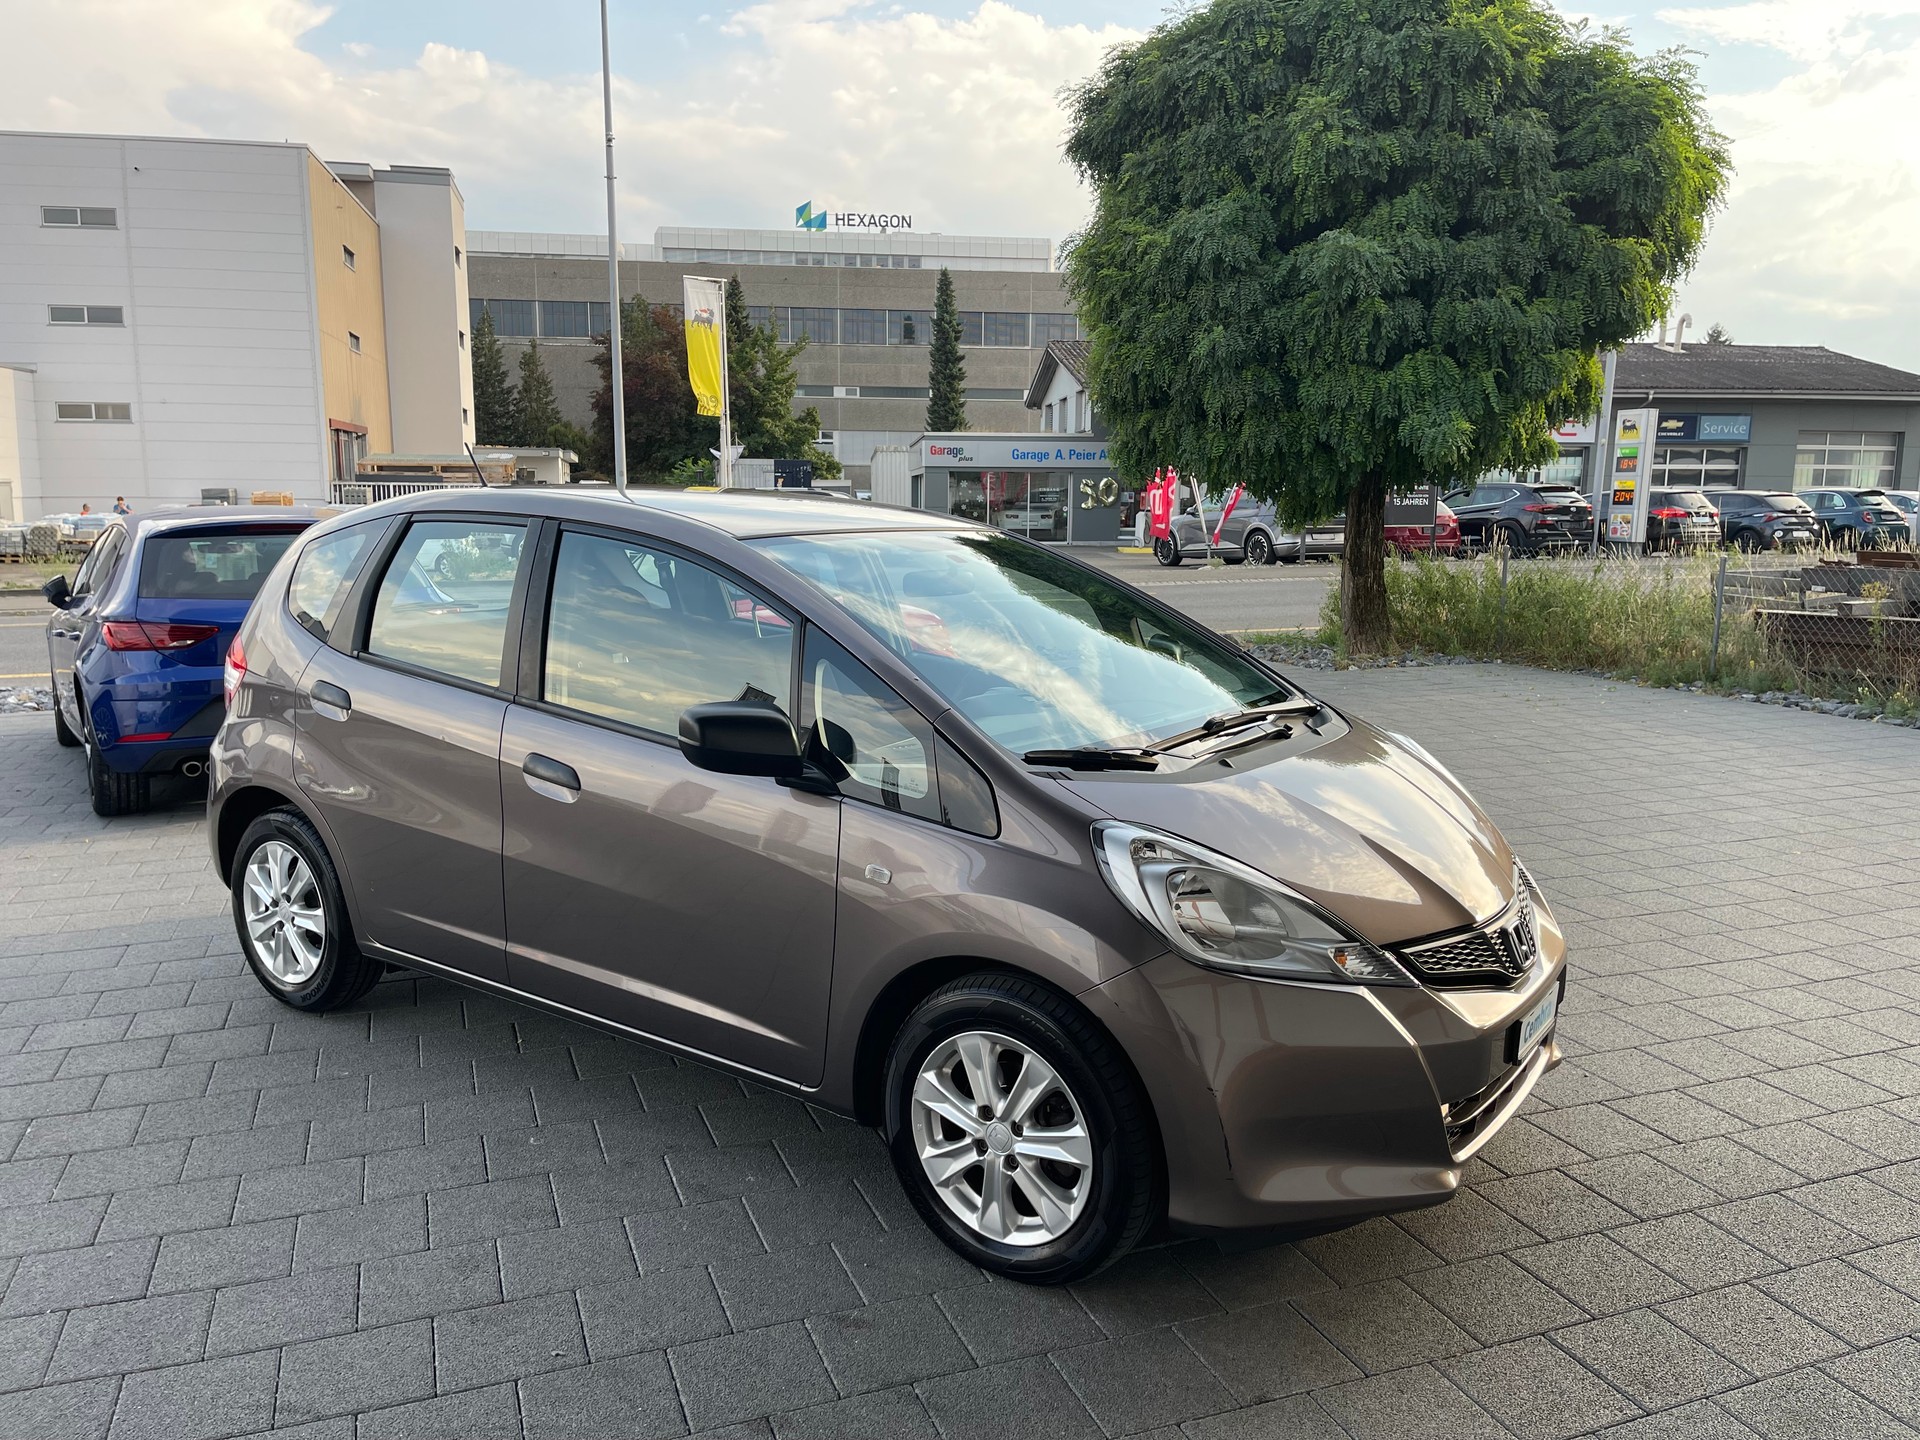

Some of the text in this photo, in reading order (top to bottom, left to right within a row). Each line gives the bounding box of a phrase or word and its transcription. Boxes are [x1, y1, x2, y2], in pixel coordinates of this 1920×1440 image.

[835, 212, 912, 228] HEXAGON
[1703, 422, 1746, 434] Service
[930, 445, 964, 458] Garage
[1011, 448, 1050, 462] Garage
[1055, 449, 1066, 460] A.
[1069, 449, 1097, 460] Peier
[1393, 498, 1429, 506] 15 JAHREN
